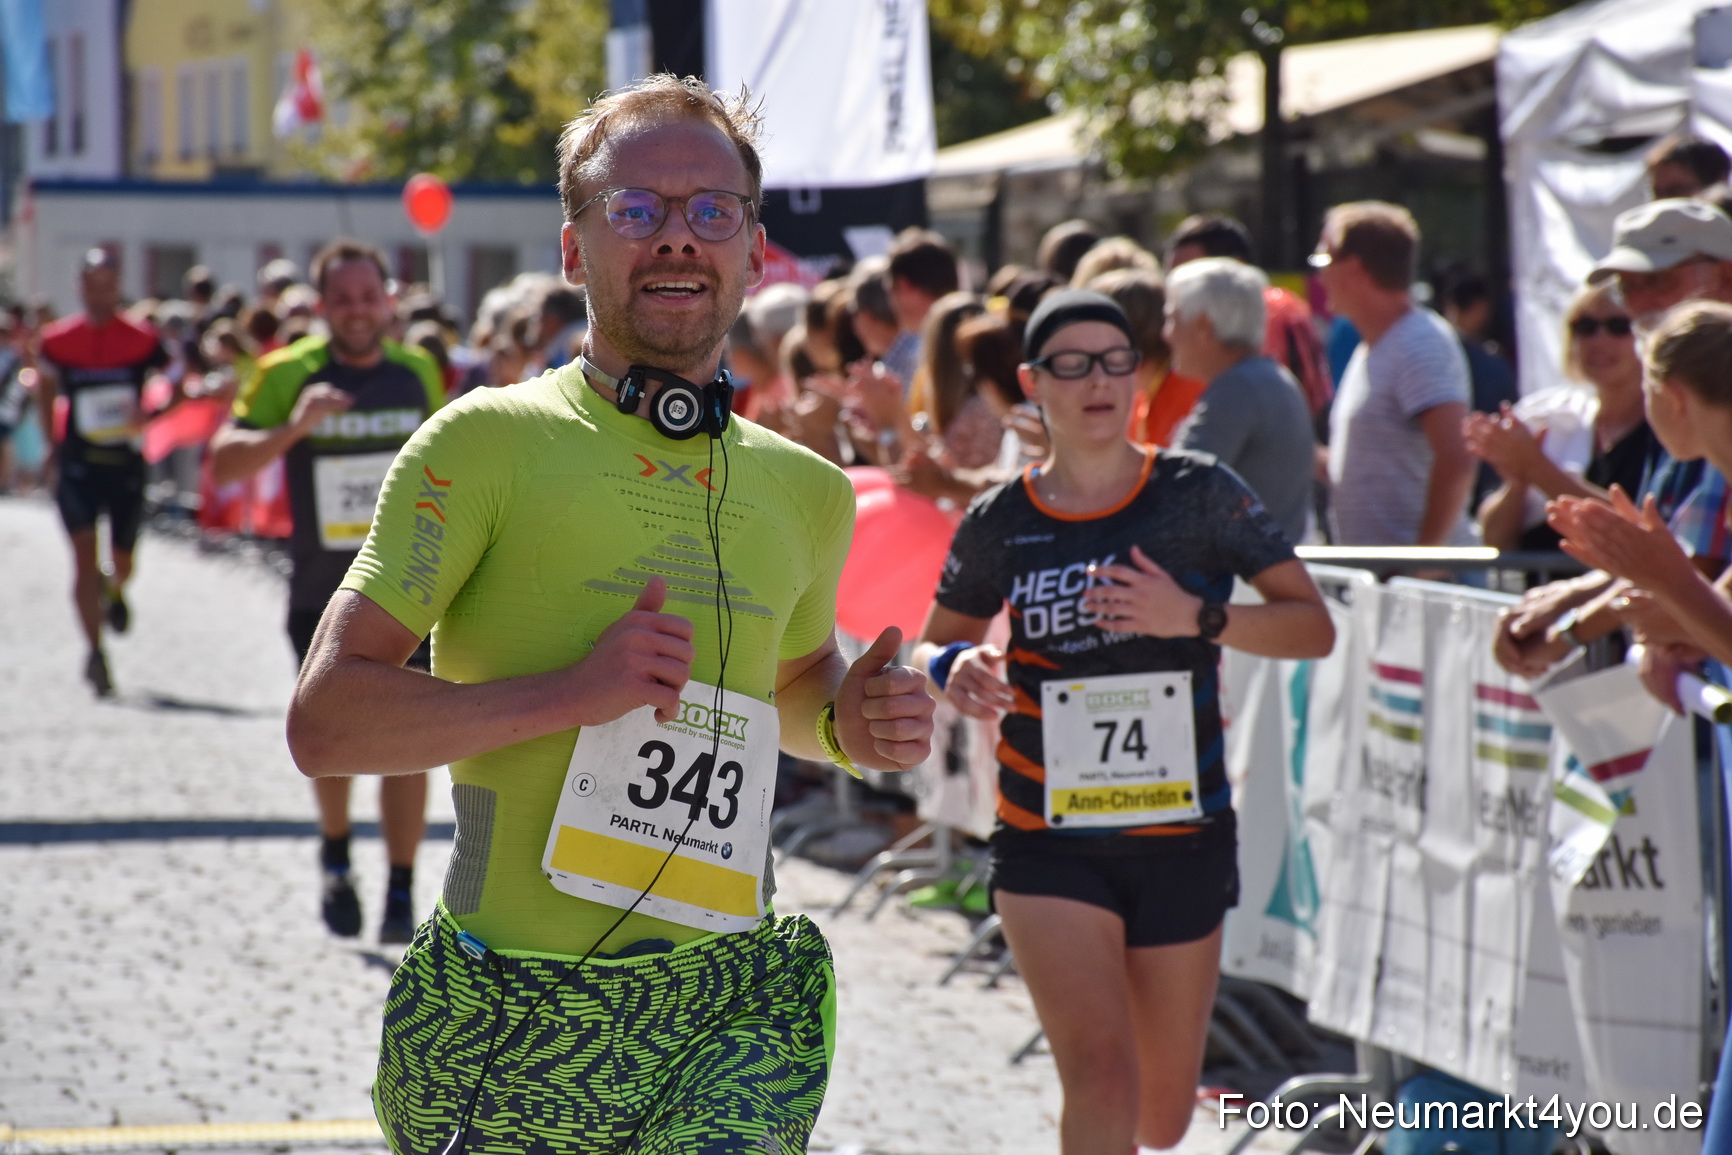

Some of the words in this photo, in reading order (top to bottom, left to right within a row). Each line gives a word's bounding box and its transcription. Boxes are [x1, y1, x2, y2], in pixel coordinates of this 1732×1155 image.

[1022, 597, 1115, 639] DES
[656, 721, 688, 735] inspired
[689, 728, 698, 738] by
[720, 738, 746, 751] concepts
[1093, 718, 1148, 764] 74
[627, 740, 744, 829] 343
[1067, 788, 1178, 811] Ann-Christin
[609, 813, 660, 839] PARTL
[662, 828, 719, 855] Neumarkt
[1574, 832, 1666, 891] arkt
